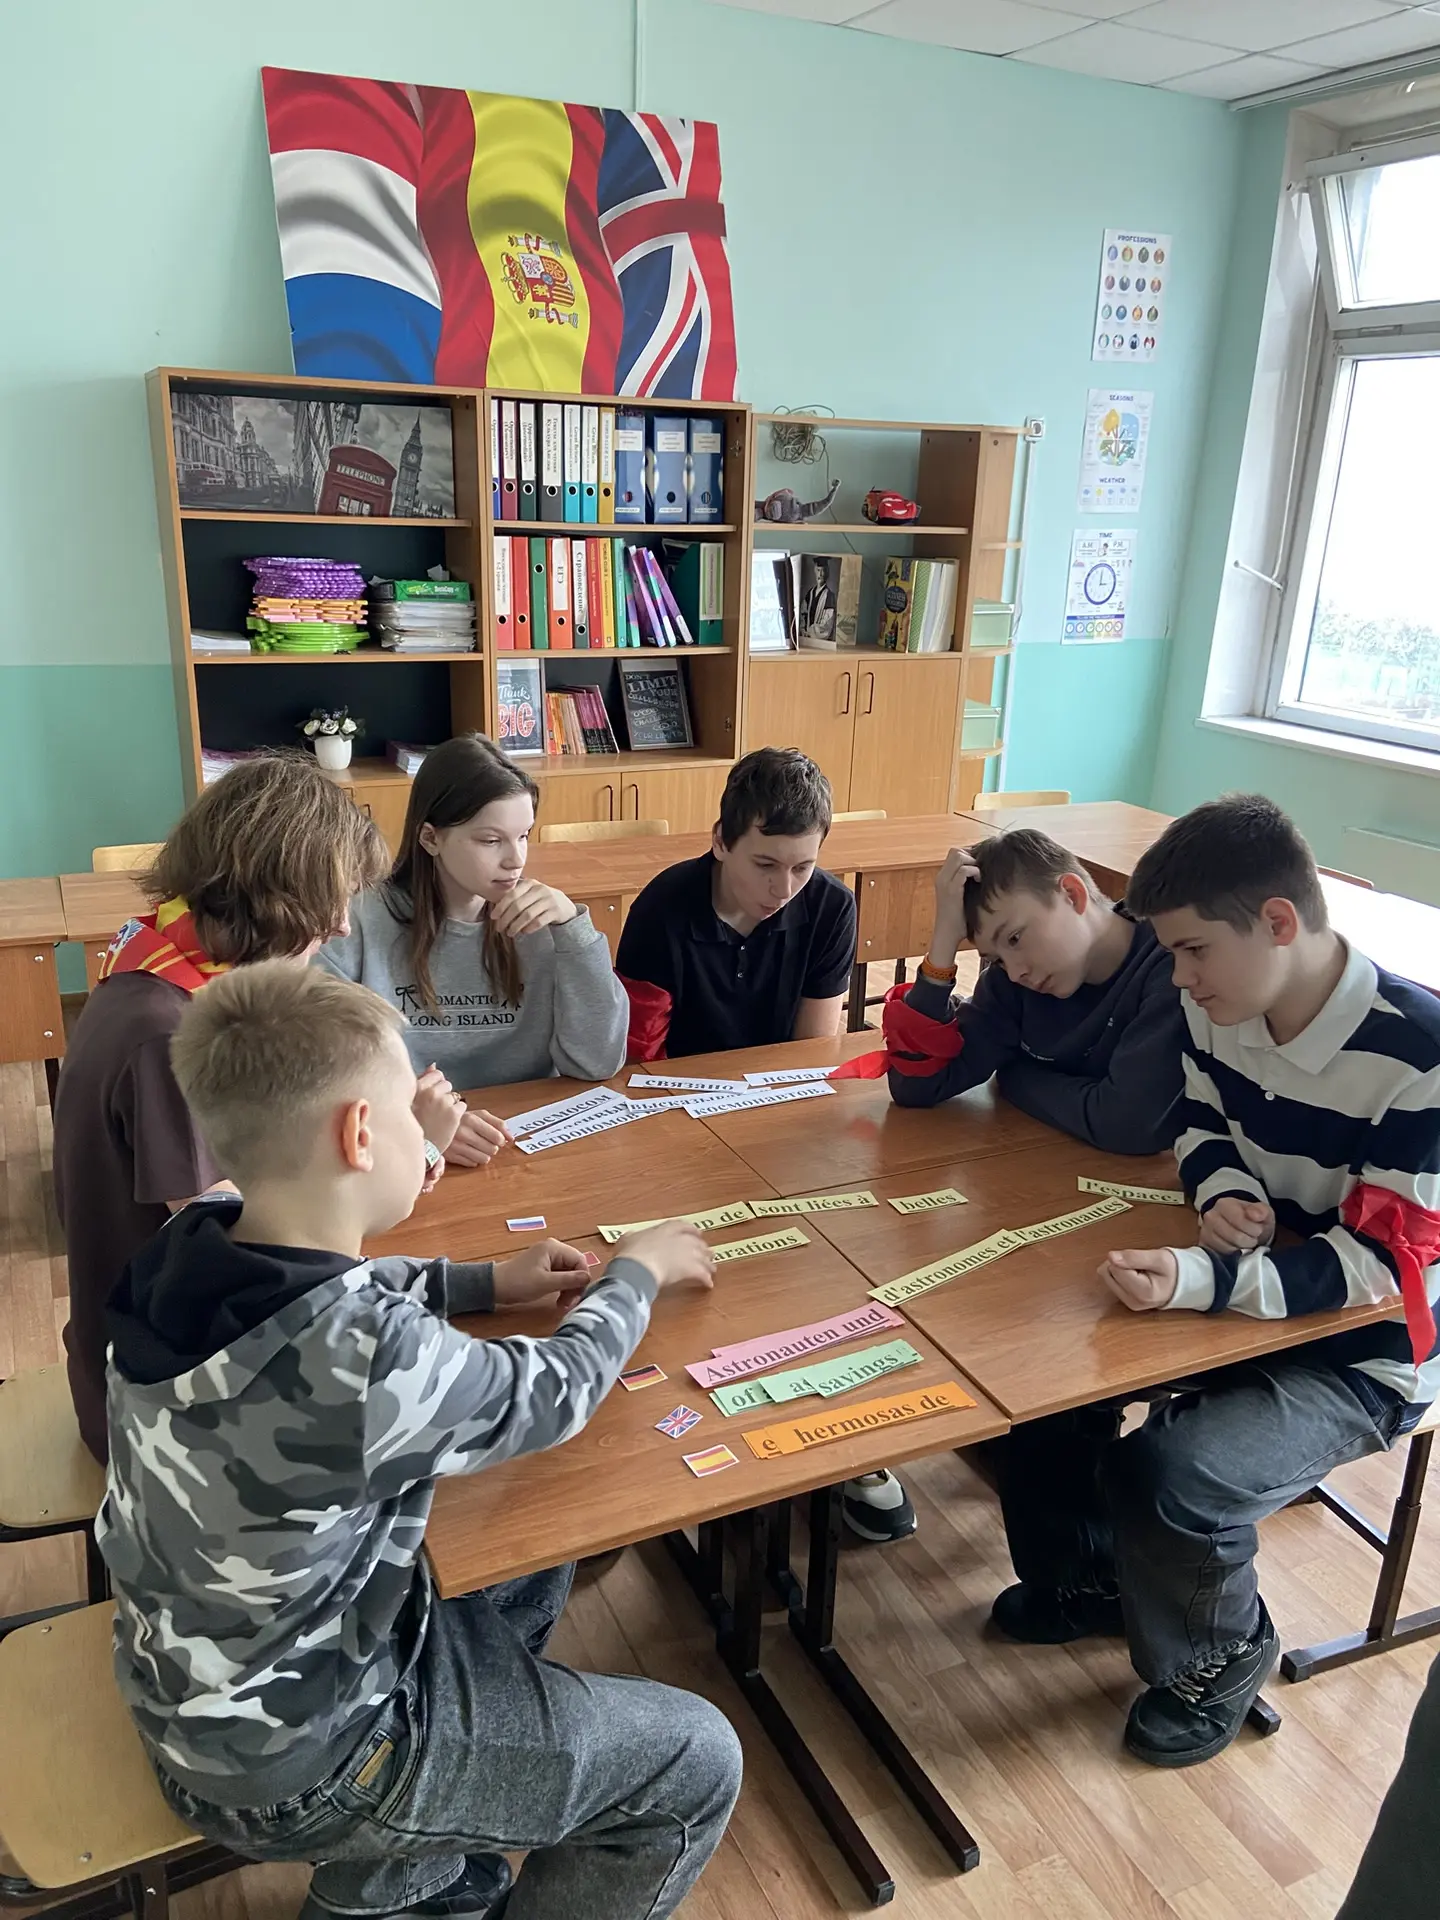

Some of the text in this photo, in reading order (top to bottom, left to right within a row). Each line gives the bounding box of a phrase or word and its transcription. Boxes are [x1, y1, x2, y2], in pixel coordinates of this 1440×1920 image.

[1109, 394, 1134, 402] SEASONS
[339, 464, 383, 485] TELEPHONE
[575, 551, 584, 614] Страноведение
[498, 684, 531, 700] Think
[627, 675, 677, 693] LIMIT
[649, 688, 678, 697] YOUR
[498, 702, 536, 739] BIG
[408, 1013, 515, 1026] LONG ISLAND
[644, 1079, 734, 1091] связано
[762, 1071, 829, 1084] немал
[694, 1088, 826, 1115] космонавтов.
[520, 1094, 613, 1132] космосом
[899, 1192, 957, 1211] belles
[1085, 1180, 1178, 1202] l'espace.
[758, 1194, 870, 1215] sont liées à
[719, 1207, 745, 1224] de
[1014, 1198, 1125, 1243] l'astronautes
[714, 1233, 799, 1262] arations
[884, 1233, 1017, 1303] d'astronomes et
[706, 1308, 886, 1382] Astronauten und
[818, 1352, 899, 1394] sayings
[731, 1387, 757, 1408] of
[794, 1391, 949, 1445] hermosas de
